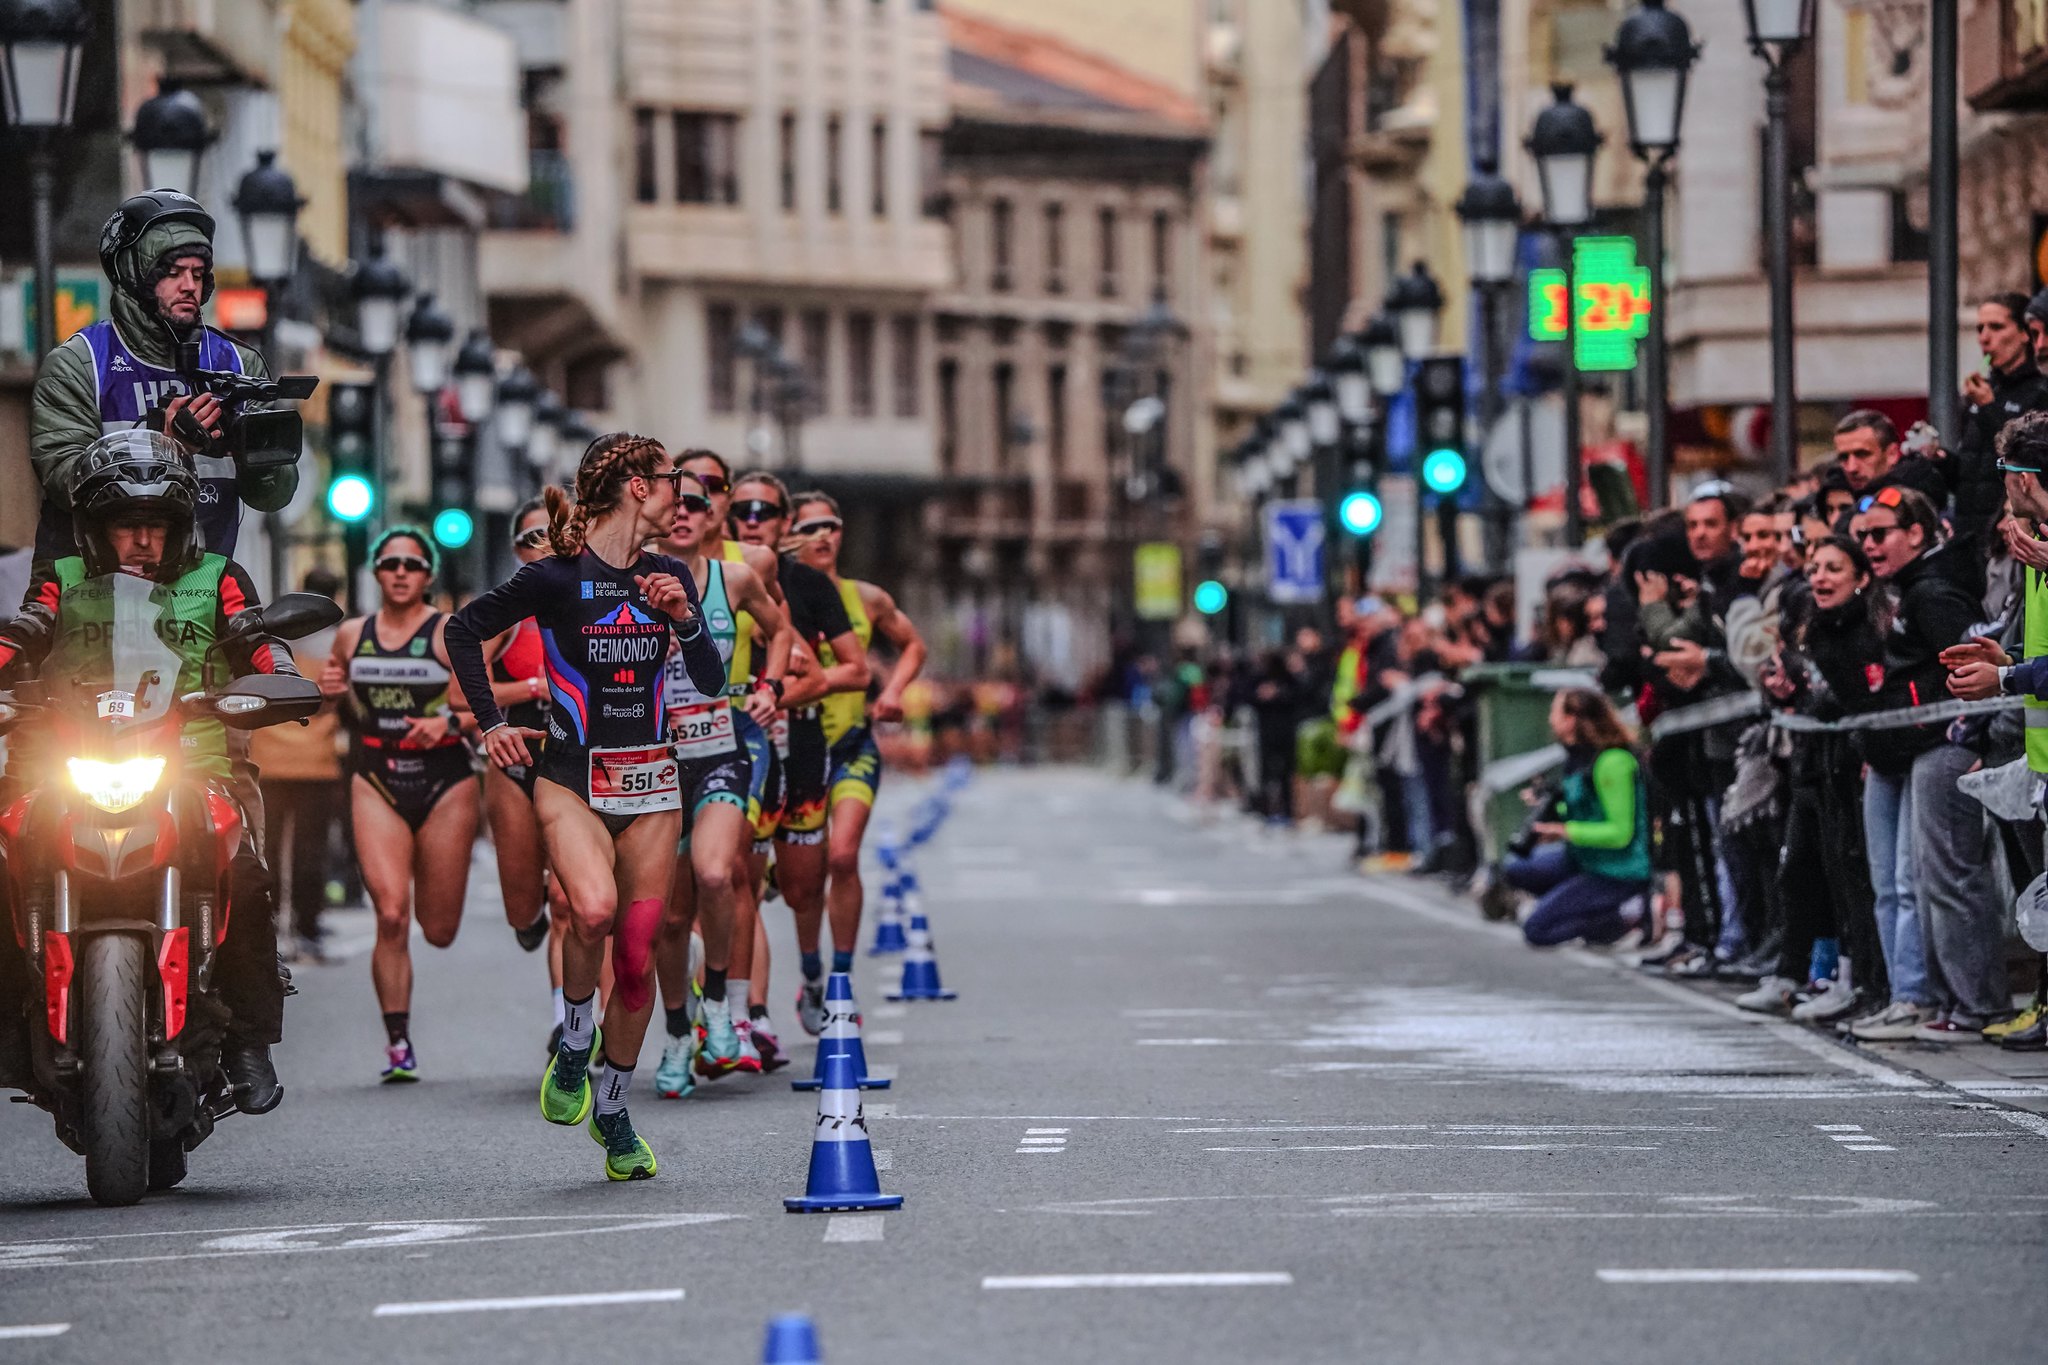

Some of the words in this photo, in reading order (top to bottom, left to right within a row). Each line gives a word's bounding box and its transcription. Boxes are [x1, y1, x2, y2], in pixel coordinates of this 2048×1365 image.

[595, 589, 604, 597] DE
[604, 589, 629, 597] GALICIA
[581, 626, 623, 635] CIDADE
[624, 625, 639, 634] DE
[641, 624, 665, 633] LUGO
[588, 636, 659, 663] REIMONDO
[633, 686, 645, 694] Lugo
[108, 701, 125, 713] 69
